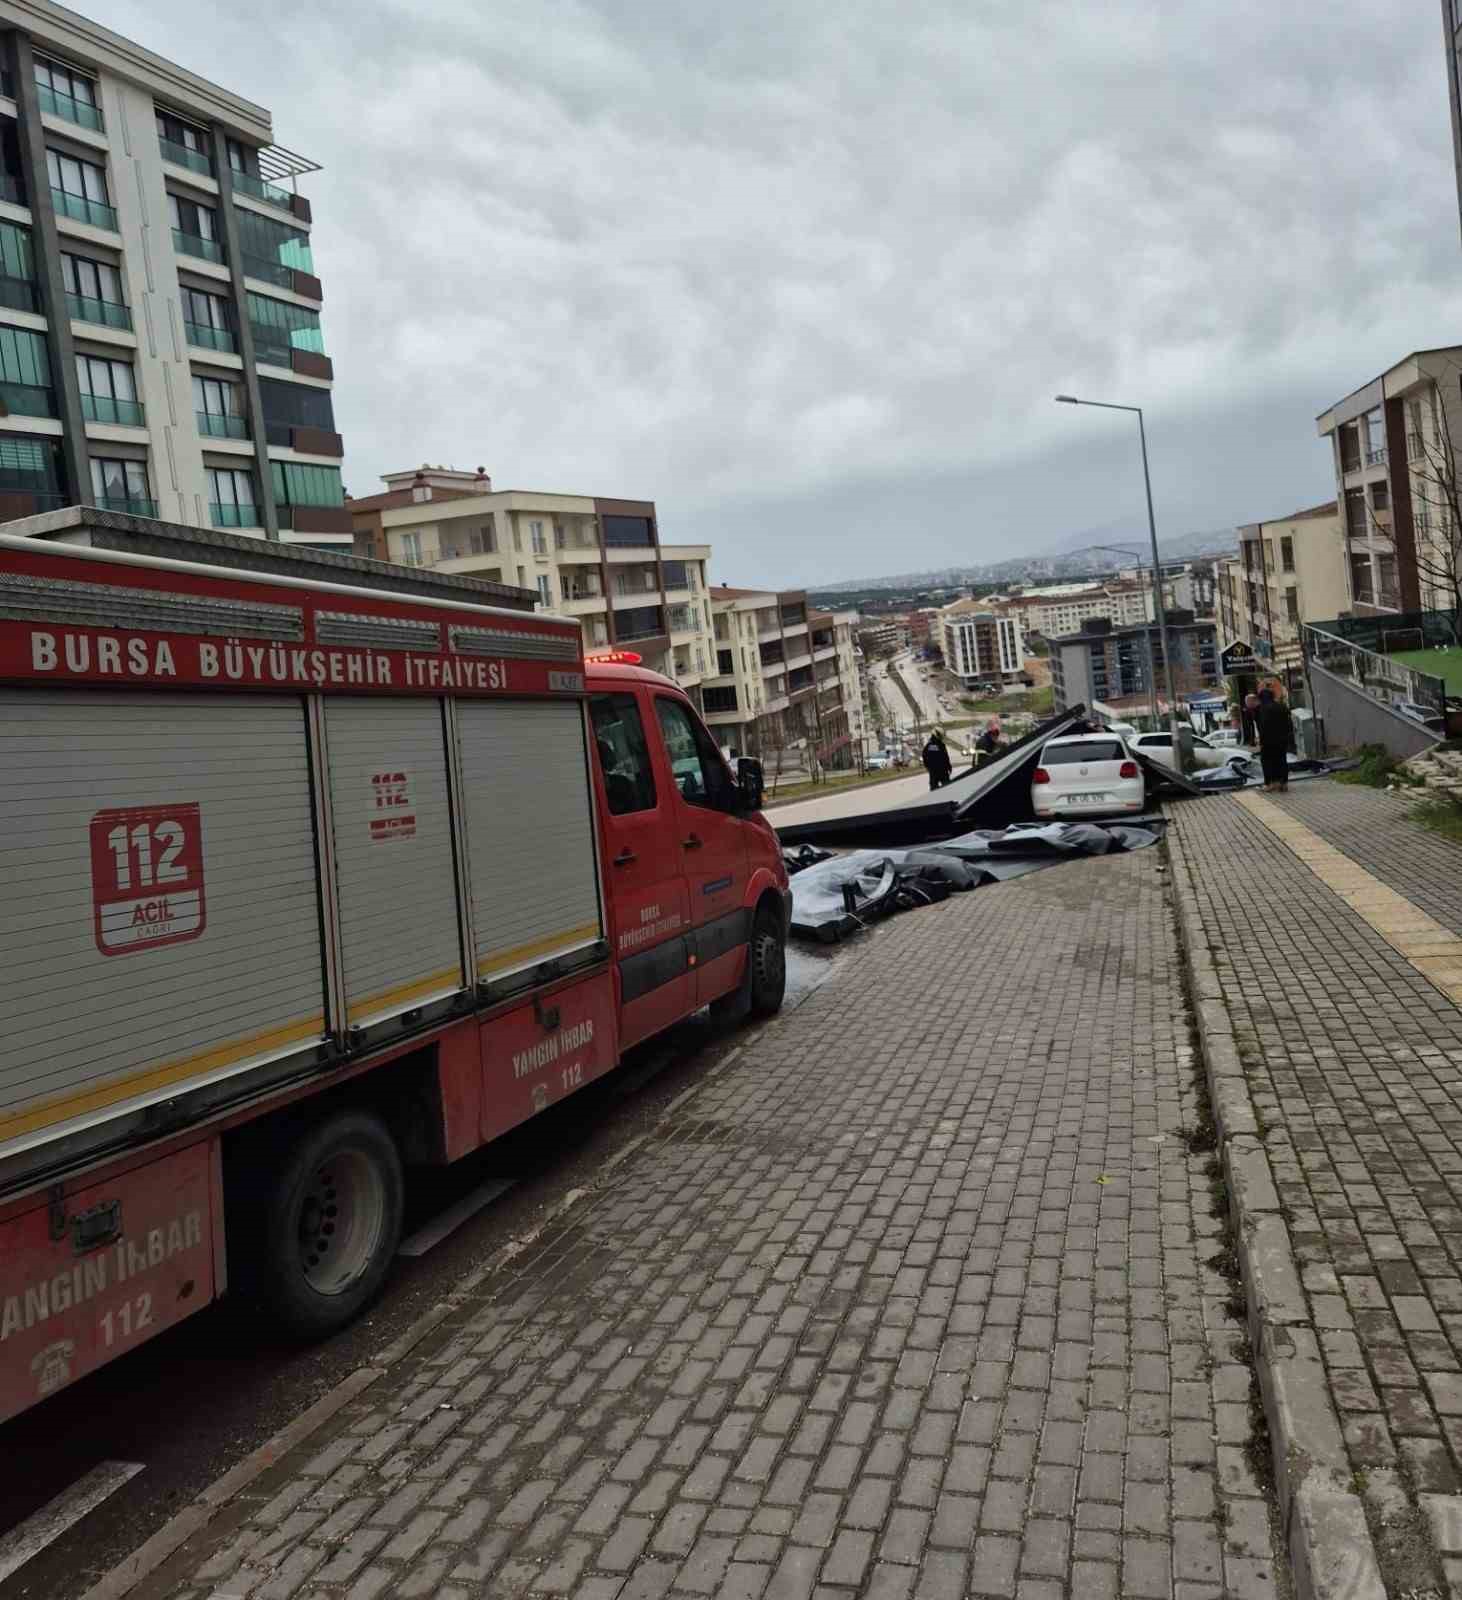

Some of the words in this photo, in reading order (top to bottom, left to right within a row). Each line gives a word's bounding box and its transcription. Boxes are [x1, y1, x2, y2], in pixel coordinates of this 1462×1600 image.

[31, 631, 177, 676] BURSA
[199, 637, 393, 687] BÜYÜKŞEHİR
[404, 651, 508, 689] İTFAİYESİ
[108, 820, 188, 890] 112
[512, 1035, 559, 1079] YANGIN
[561, 1063, 582, 1089] 112
[101, 1292, 153, 1347] 112
